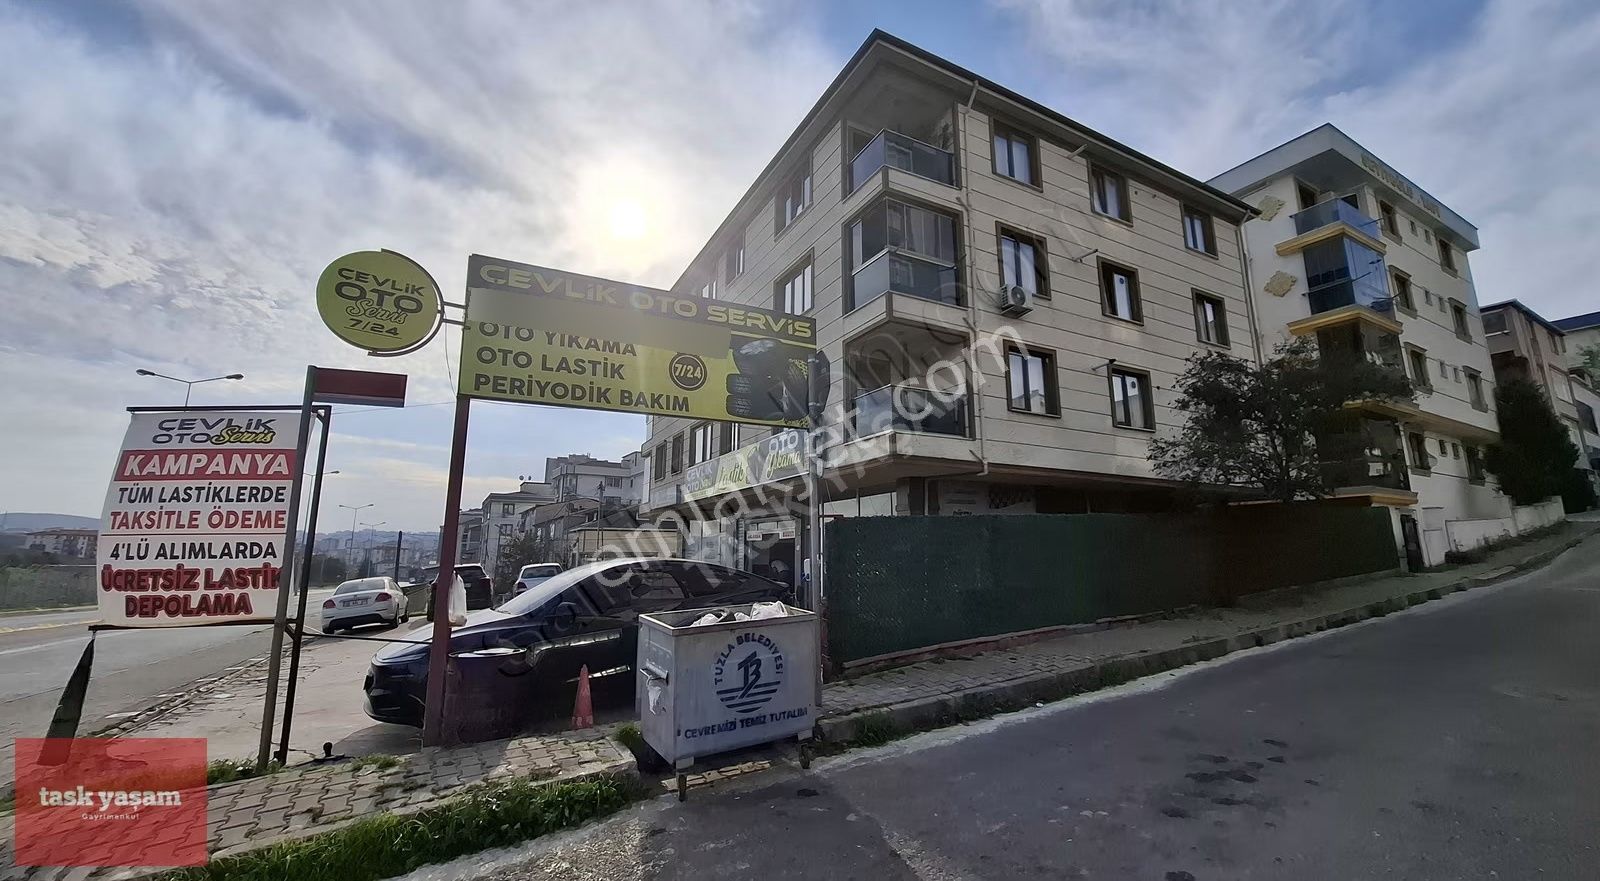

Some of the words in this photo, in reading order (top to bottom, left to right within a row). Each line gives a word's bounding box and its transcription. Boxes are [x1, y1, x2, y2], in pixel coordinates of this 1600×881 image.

[334, 281, 424, 315] OTO
[629, 291, 699, 319] OTO
[345, 297, 410, 325] Servis
[349, 318, 400, 336] 7/24
[478, 321, 536, 343] OTO
[544, 331, 638, 358] YIKAMA
[476, 346, 533, 370] OTO
[540, 354, 626, 381] LASTİK
[673, 362, 703, 382] 7/24
[474, 373, 613, 406] PERİYODİK
[619, 389, 691, 413] BAKIM
[151, 432, 212, 444] OTO
[768, 430, 799, 453] OTO
[123, 453, 290, 477] KAMPANYA
[118, 483, 153, 504] TÜM
[158, 481, 287, 504] LASTİKLERDE
[109, 505, 201, 530] TAKSİTLE
[207, 505, 287, 529] ÖDEME
[109, 537, 150, 561] 4'LÜ
[154, 541, 278, 561] ALIMLARDA
[100, 563, 200, 592] ÜCRETSİZ
[203, 562, 283, 591] LASTİK
[124, 592, 254, 618] DEPOLAMA
[714, 643, 735, 685] TUZLA
[769, 706, 808, 723] TUTALIM
